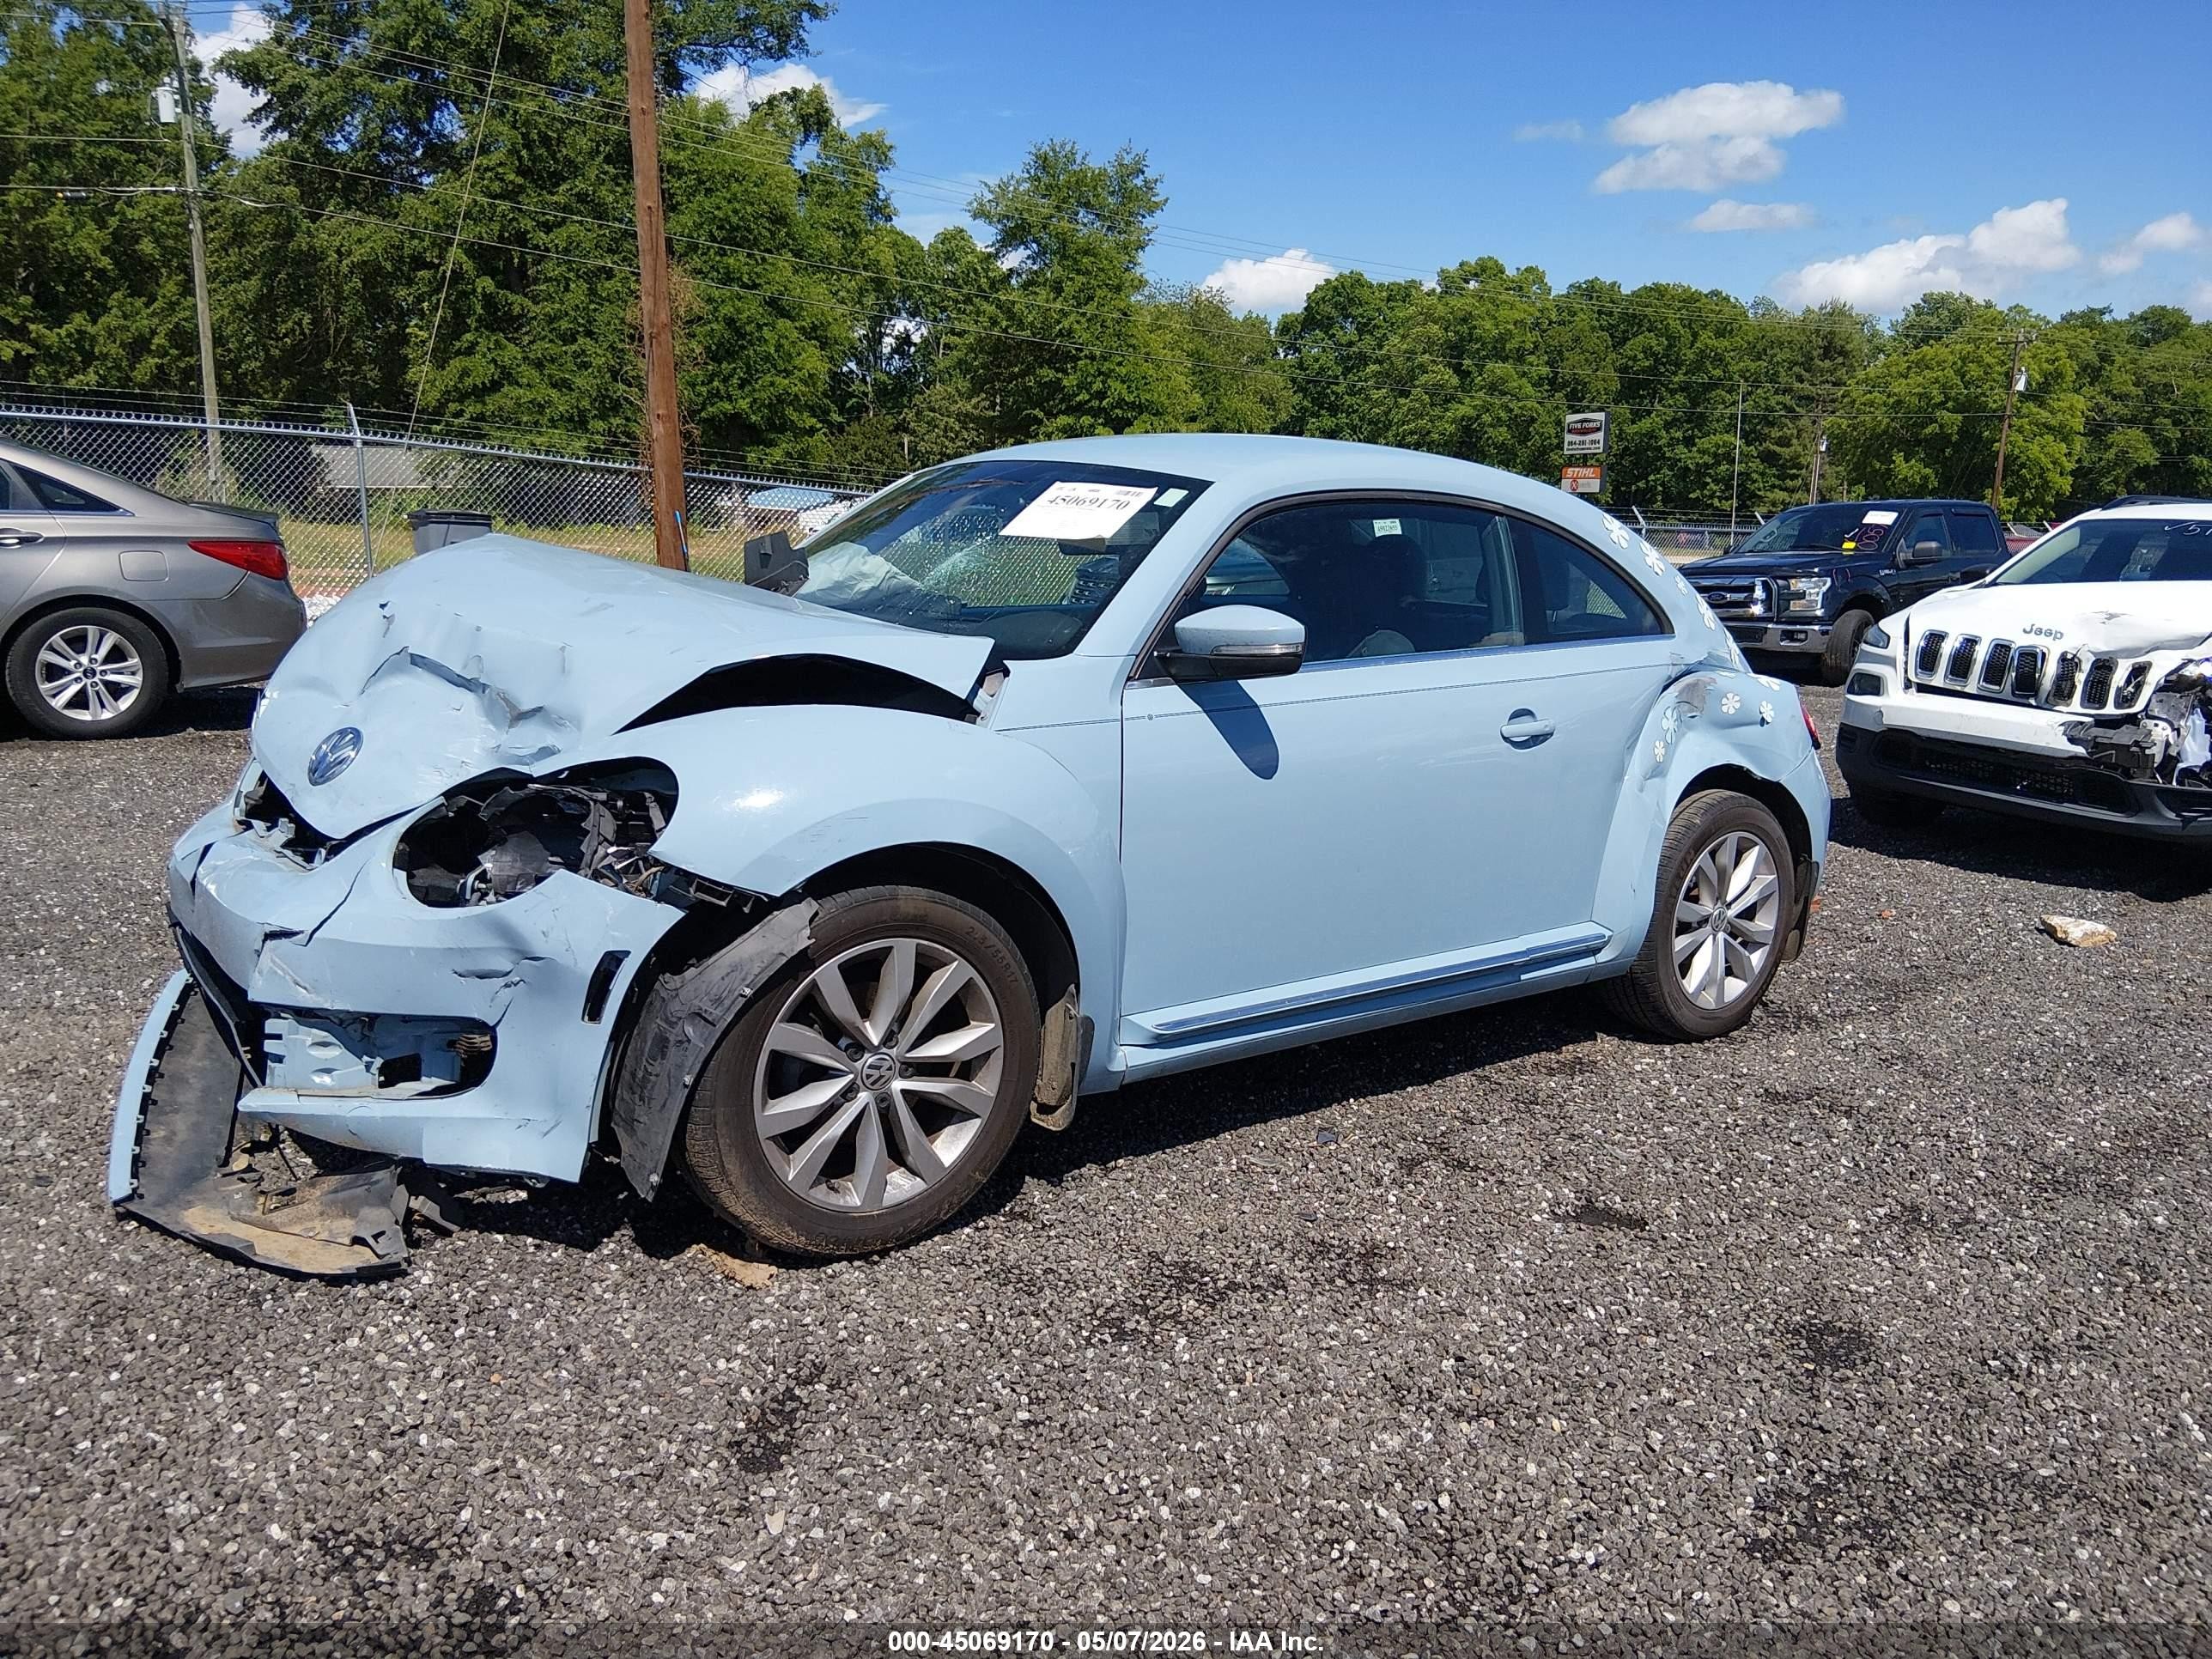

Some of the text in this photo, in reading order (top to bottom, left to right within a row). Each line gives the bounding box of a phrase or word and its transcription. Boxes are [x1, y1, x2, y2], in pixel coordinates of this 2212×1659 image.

[1565, 467, 1596, 477] STIHL
[1047, 495, 1131, 510] 45069170
[2022, 623, 2064, 641] Jeep
